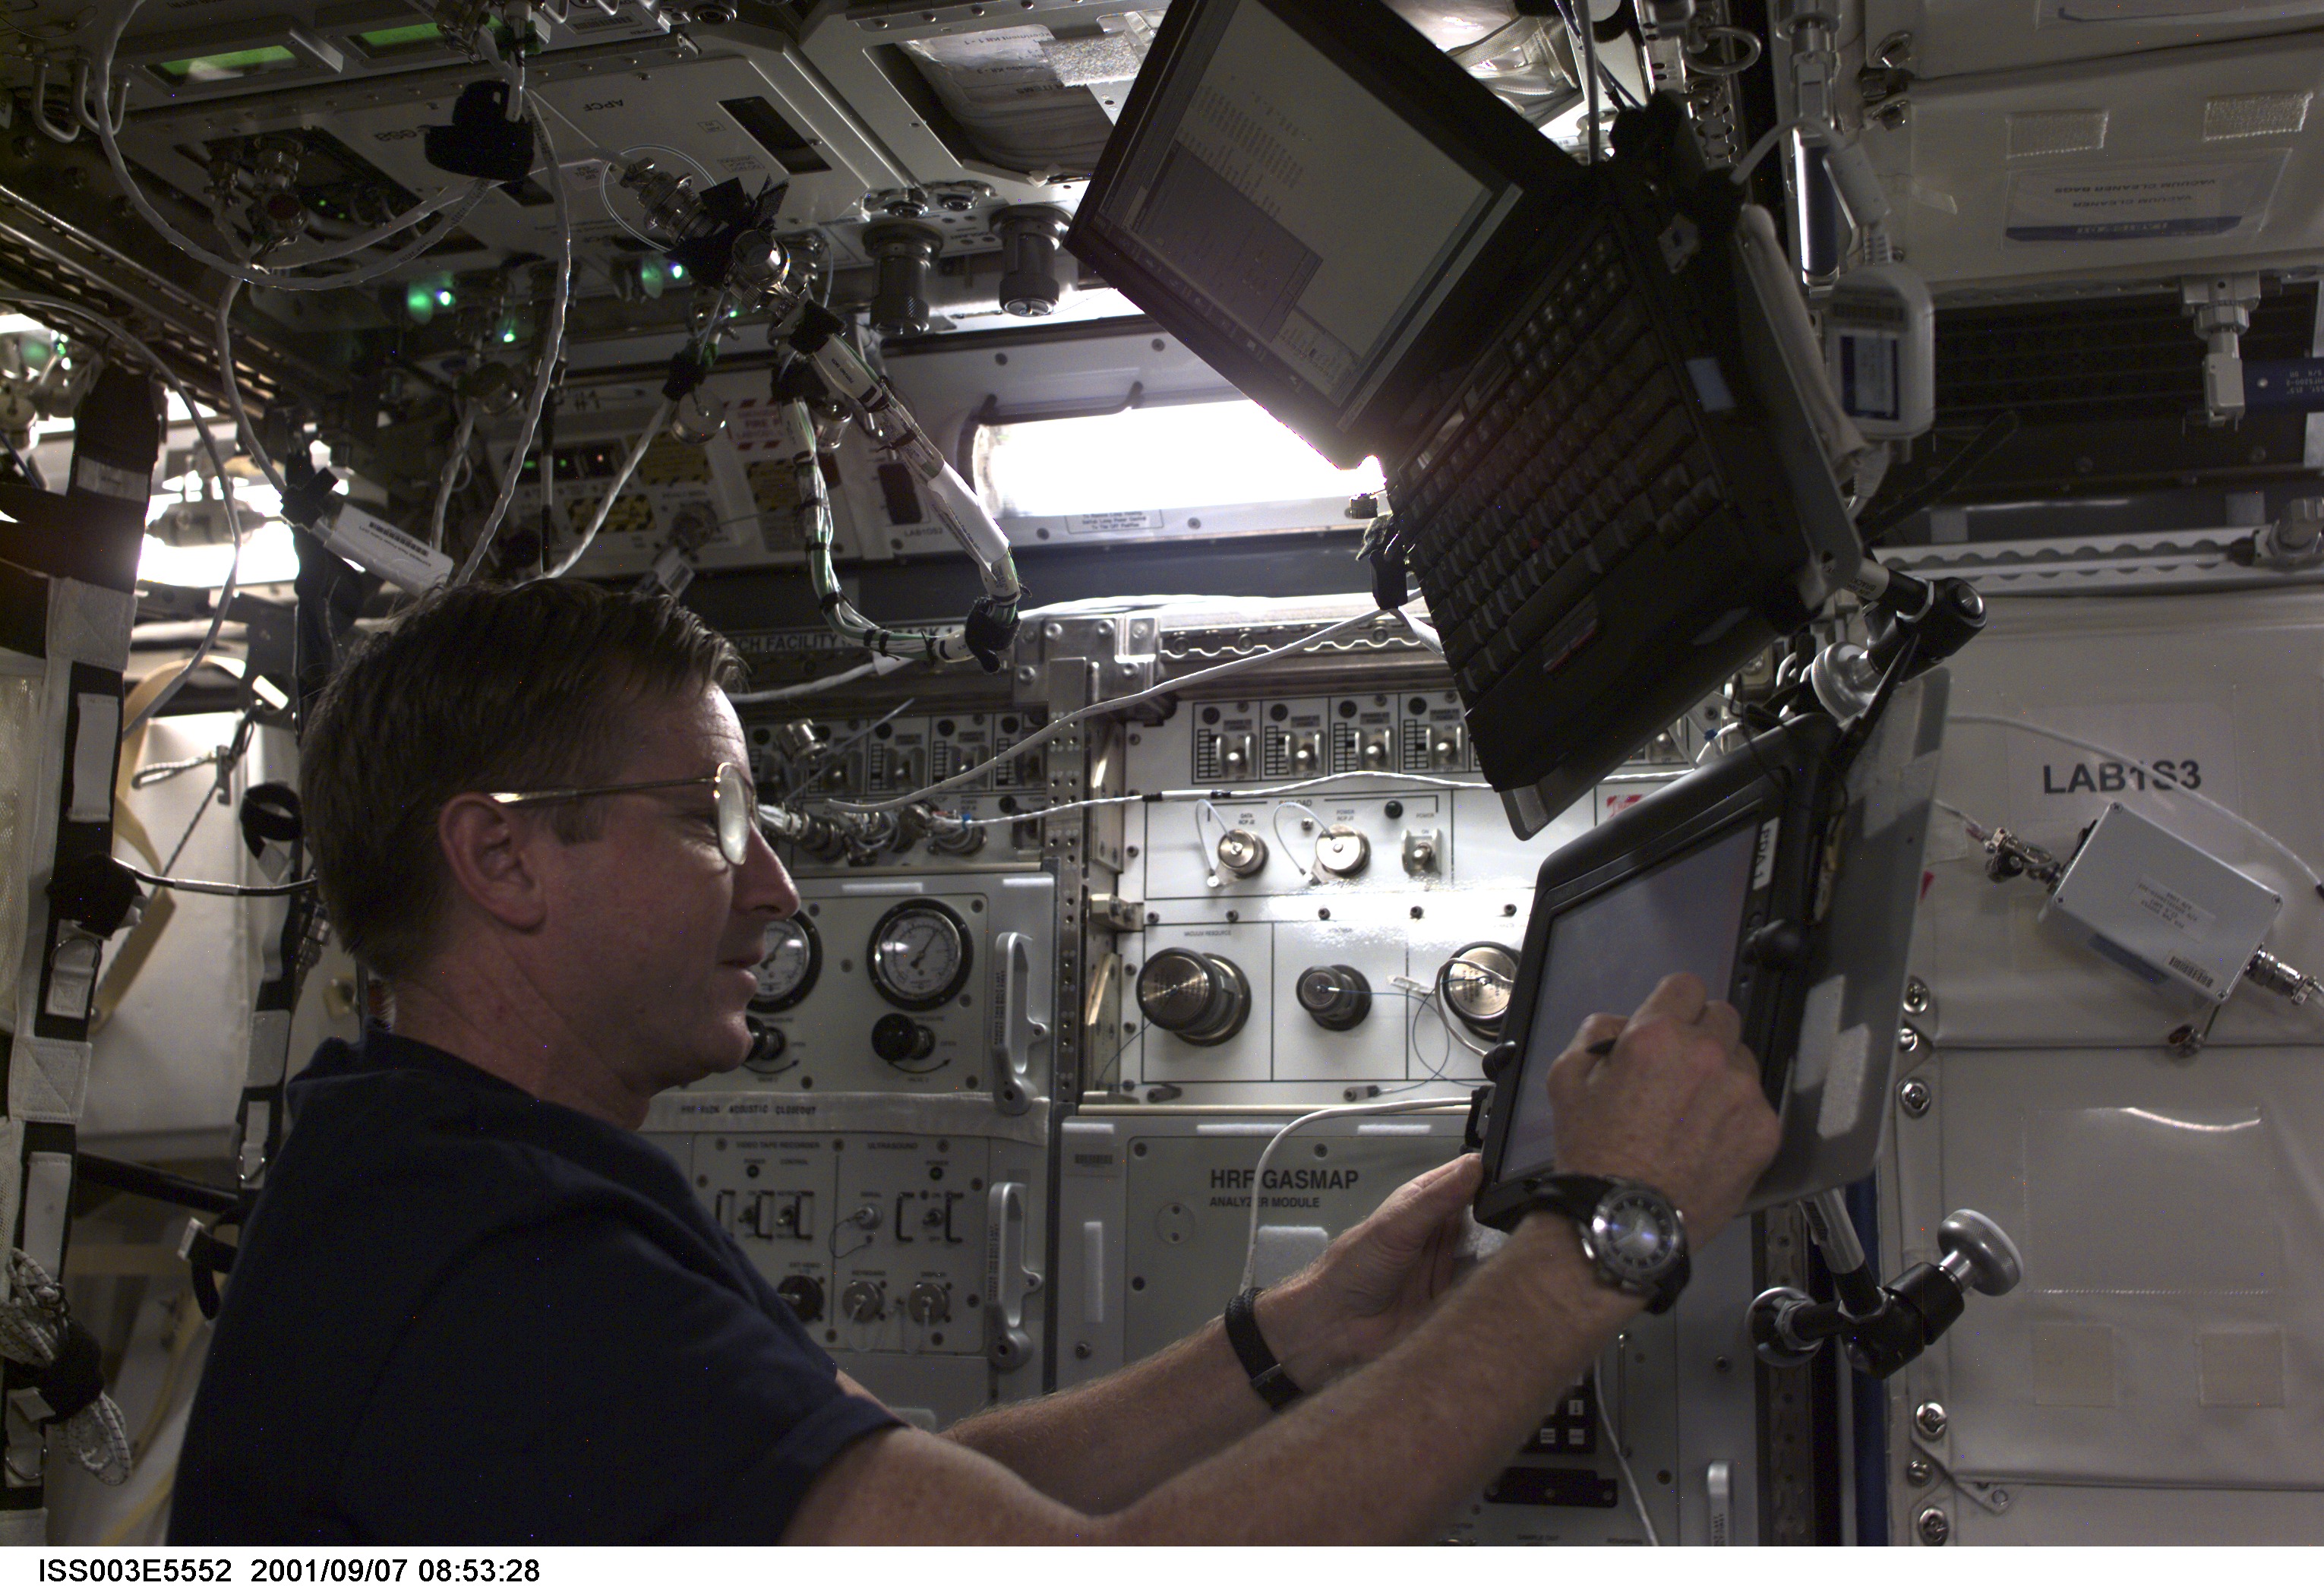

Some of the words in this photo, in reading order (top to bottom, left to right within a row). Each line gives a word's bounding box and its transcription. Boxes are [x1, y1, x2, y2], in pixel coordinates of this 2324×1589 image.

[583, 99, 624, 112] APCF
[2095, 183, 2157, 192] CLEANER
[2161, 178, 2215, 188] VACUUM
[2073, 198, 2133, 208] CLEANER
[2138, 194, 2192, 204] VACUUM
[769, 633, 836, 650] FACILITY
[2043, 759, 2202, 794] LAB1S3
[1757, 826, 1770, 865] PDA
[1211, 1169, 1254, 1189] HRF
[1261, 1169, 1359, 1189] GASMAP
[1271, 1196, 1320, 1208] MODULE
